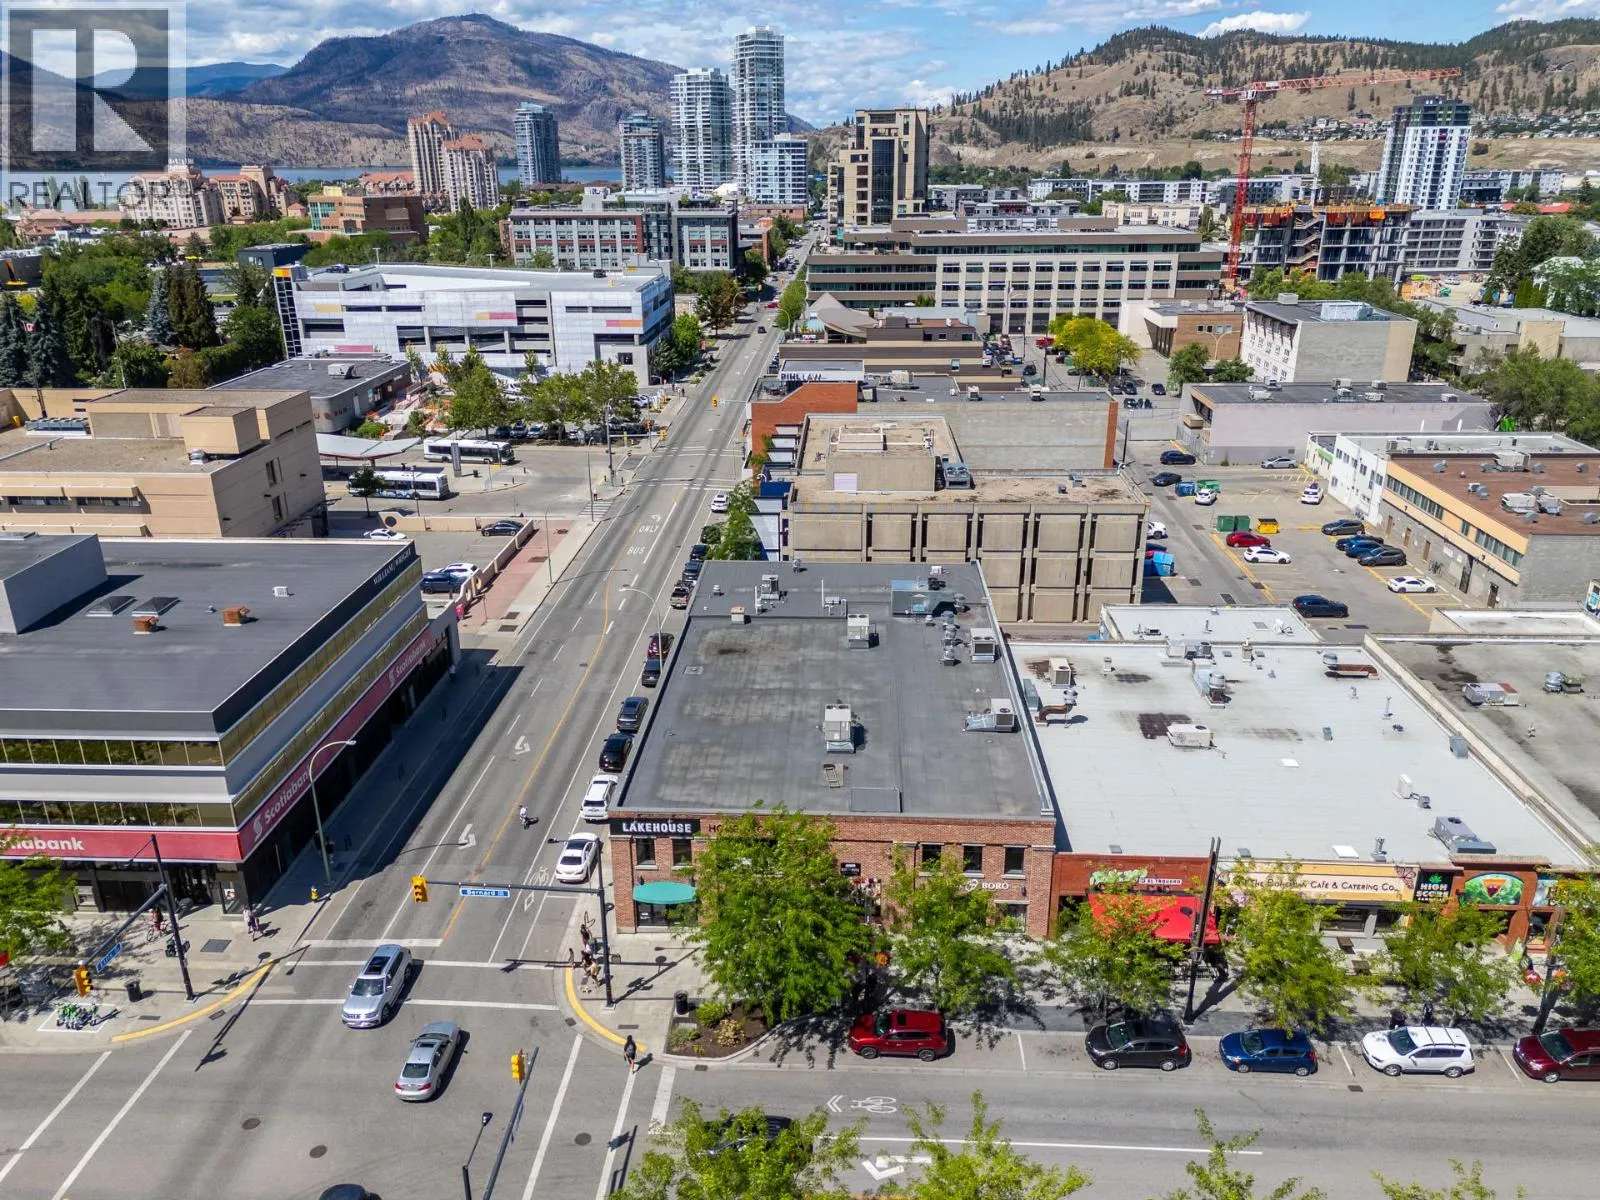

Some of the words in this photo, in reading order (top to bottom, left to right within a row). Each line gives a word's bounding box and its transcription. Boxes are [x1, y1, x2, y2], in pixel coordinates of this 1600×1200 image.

[626, 546, 646, 555] BUS
[622, 822, 692, 833] LAKEHOUSE
[1420, 883, 1448, 891] HIGH
[467, 889, 496, 897] Bernard
